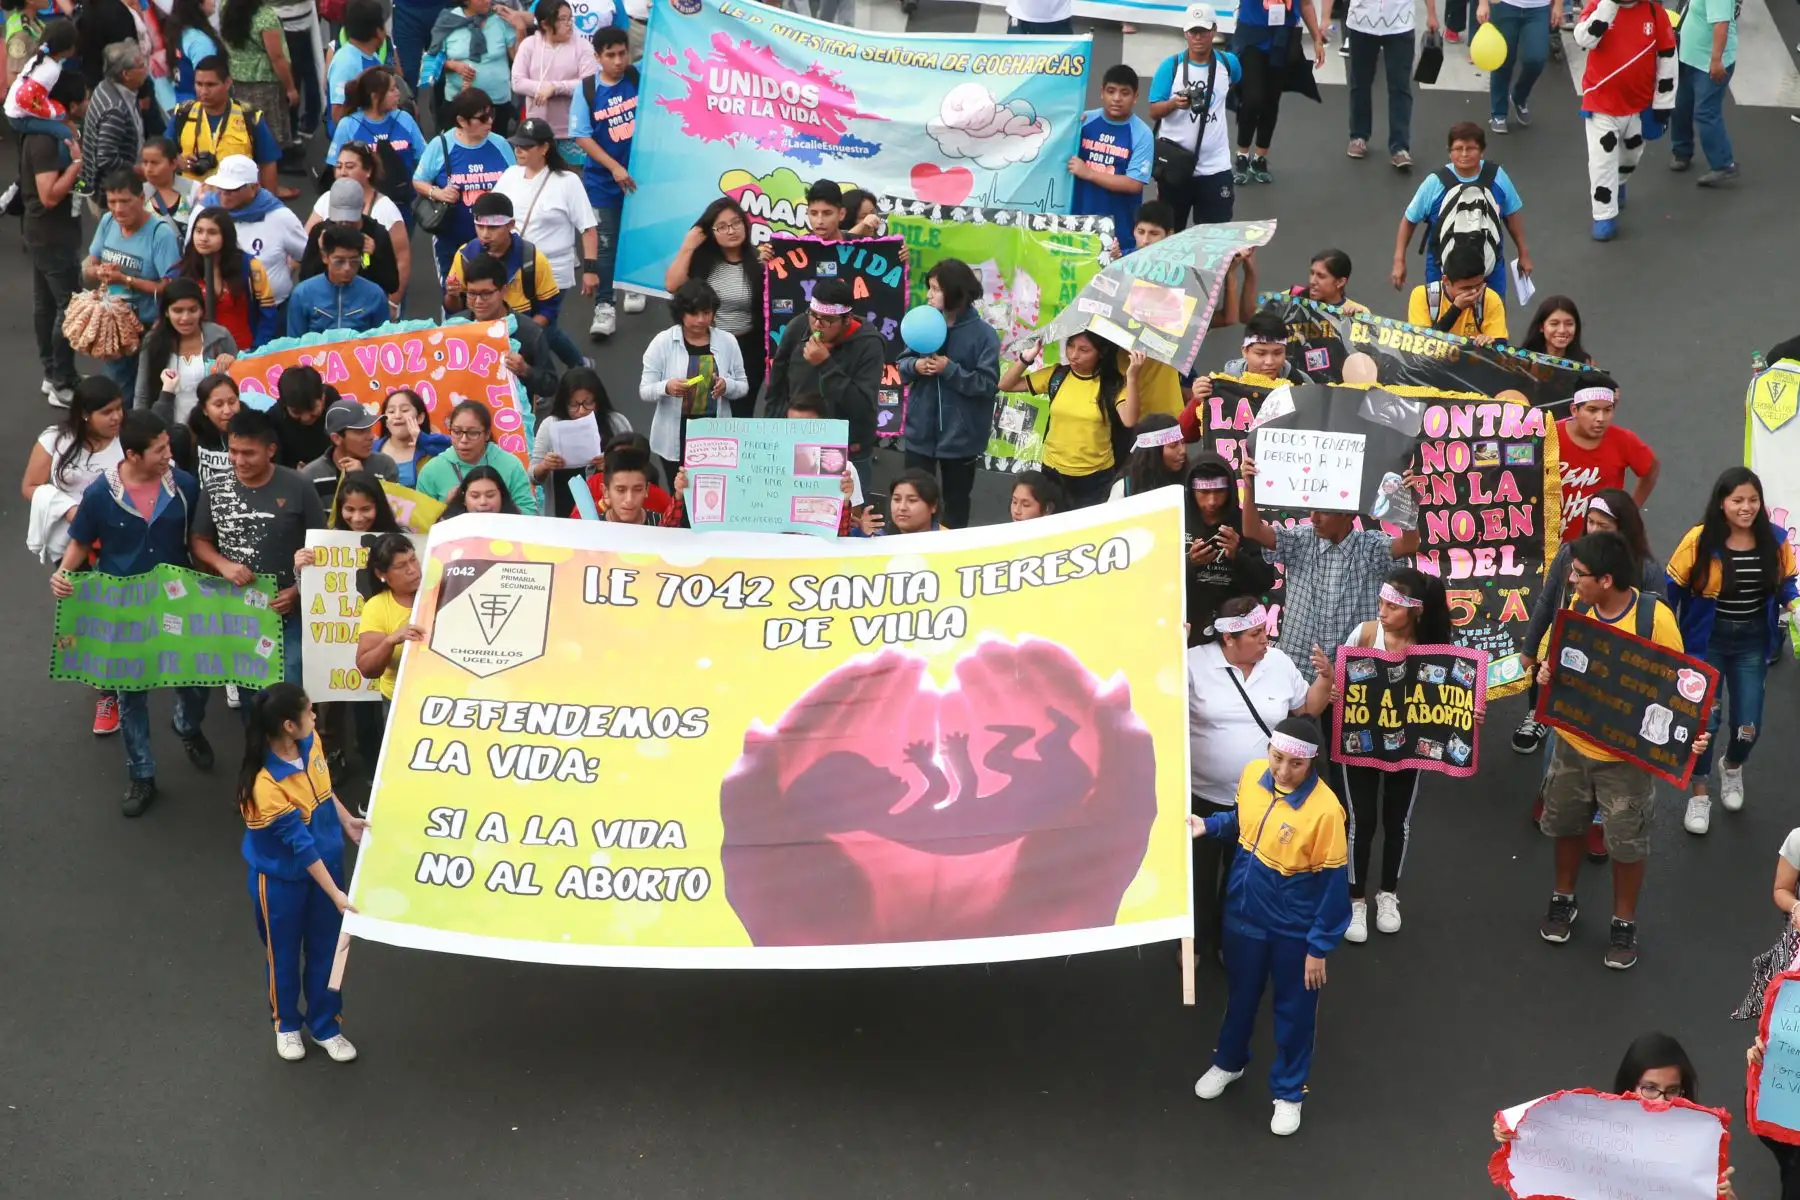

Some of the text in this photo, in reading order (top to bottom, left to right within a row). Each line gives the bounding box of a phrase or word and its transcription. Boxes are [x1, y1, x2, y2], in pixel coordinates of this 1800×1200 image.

[572, 3, 589, 14] YO
[770, 22, 859, 59] NUESTRA
[860, 43, 937, 70] SEÑORA
[940, 53, 967, 72] DE
[971, 54, 1085, 77] COCHARCAS
[709, 67, 820, 109] UNIDOS
[608, 95, 623, 106] SOY
[707, 95, 821, 126] POR LA VIDA
[608, 110, 634, 127] POR LA
[1190, 112, 1218, 124] VDA
[781, 138, 869, 154] #LacalleEsnuestra
[1099, 133, 1116, 144] SOY
[468, 164, 484, 173] SOY
[1089, 152, 1115, 165] POR LA
[768, 247, 809, 280] TU
[835, 244, 903, 289] VIDA
[1350, 321, 1371, 344] EL
[1378, 326, 1459, 362] DERECHO
[354, 339, 427, 377] VOZ
[445, 338, 498, 378] DE
[1208, 397, 1547, 439] LA ONTRA
[1262, 431, 1366, 454] TODOS TENEMOS
[1263, 449, 1312, 465] DERECHO
[1319, 452, 1327, 467] A
[1287, 476, 1330, 493] VIDA
[1467, 470, 1522, 505] LA
[1480, 504, 1534, 541] EN
[313, 545, 371, 568] DILE
[1447, 545, 1525, 580] DEL
[325, 571, 347, 593] SI
[446, 566, 476, 577] 7042
[500, 575, 536, 583] PRIMARIA
[502, 567, 528, 575] INICIAL
[657, 571, 775, 611] 7042
[789, 570, 940, 611] SANTA
[956, 536, 1131, 599] TERESA
[500, 582, 546, 591] SECUNDARIA
[310, 593, 366, 618] A LA
[310, 621, 361, 645] VIDA
[763, 605, 967, 651] DE VILLA
[450, 648, 523, 658] CHORRILLOS
[462, 657, 494, 665] UGEL
[329, 668, 362, 691] NO
[1346, 683, 1474, 712] SI A LA VIDA
[420, 695, 709, 739] DEFENDEMOS
[1344, 703, 1473, 731] NO AL ABORTO
[408, 738, 600, 783] LA VIDA:
[425, 807, 687, 850] SI A LA VIDA
[415, 852, 711, 902] NO AL ABORTO
